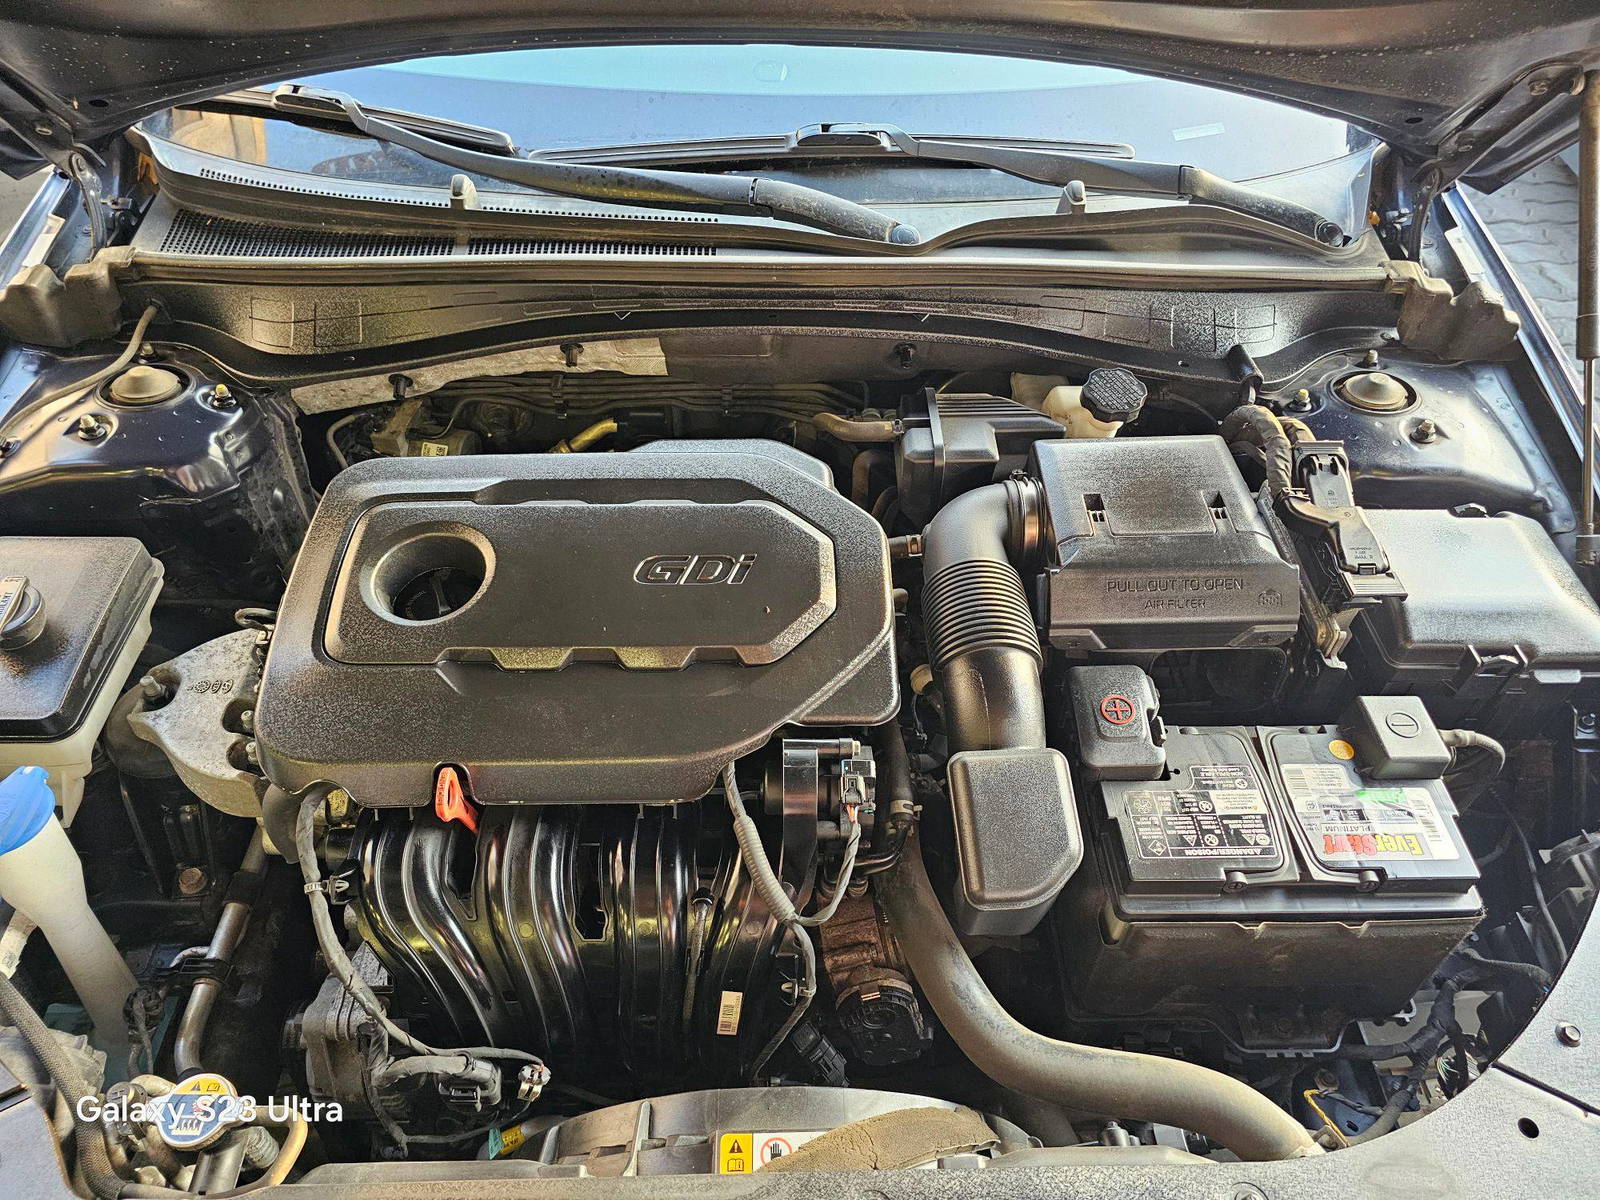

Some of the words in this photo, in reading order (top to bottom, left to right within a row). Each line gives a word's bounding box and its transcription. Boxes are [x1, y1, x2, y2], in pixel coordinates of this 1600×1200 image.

[633, 553, 757, 585] GDi
[1107, 580, 1144, 592] PULL
[1147, 579, 1178, 592] OUT
[1180, 579, 1199, 591] TO
[1203, 578, 1244, 590] OPEN
[1144, 600, 1164, 610] AIR
[1167, 600, 1206, 609] FILTER
[1323, 833, 1424, 856] EverStart
